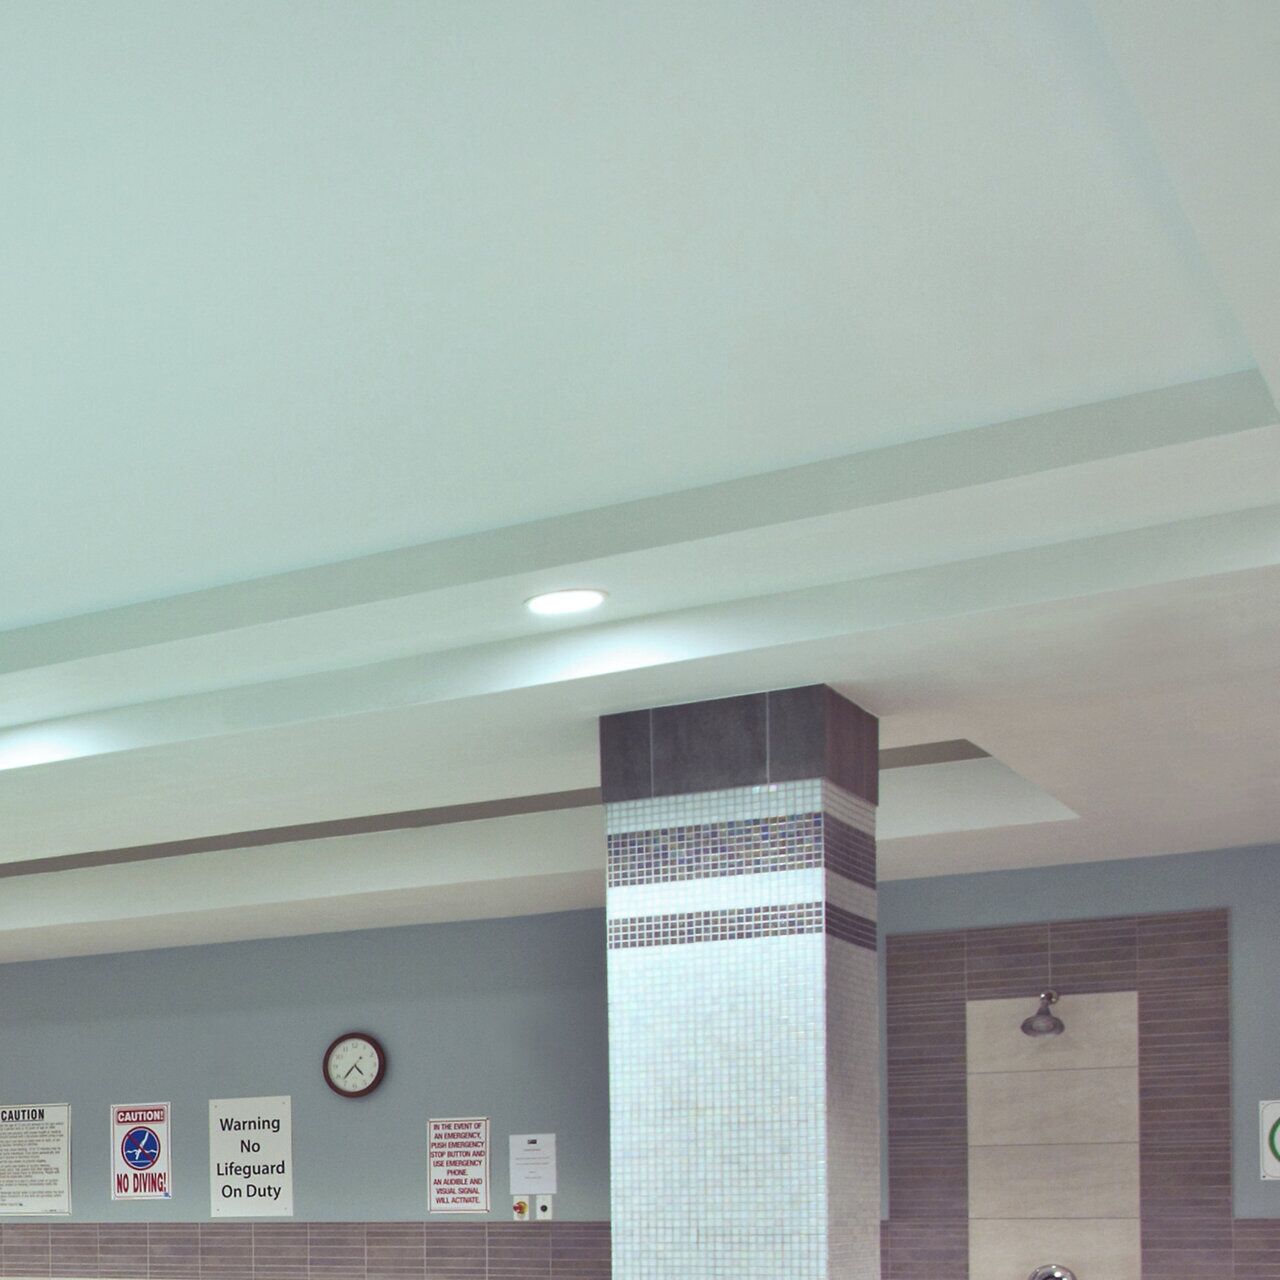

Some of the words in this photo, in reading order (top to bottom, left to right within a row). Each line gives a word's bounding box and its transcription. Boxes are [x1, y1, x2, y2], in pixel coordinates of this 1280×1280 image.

[1, 1109, 45, 1121] CAUTION
[118, 1111, 164, 1122] CAUTION!
[220, 1117, 280, 1132] Warning
[453, 1122, 472, 1130] EVENT
[241, 1140, 260, 1153] No
[217, 1161, 285, 1178] Lifeguard
[116, 1173, 129, 1193] NO
[133, 1172, 167, 1193] DIVING!
[222, 1185, 242, 1198] On
[247, 1184, 281, 1200] Duty
